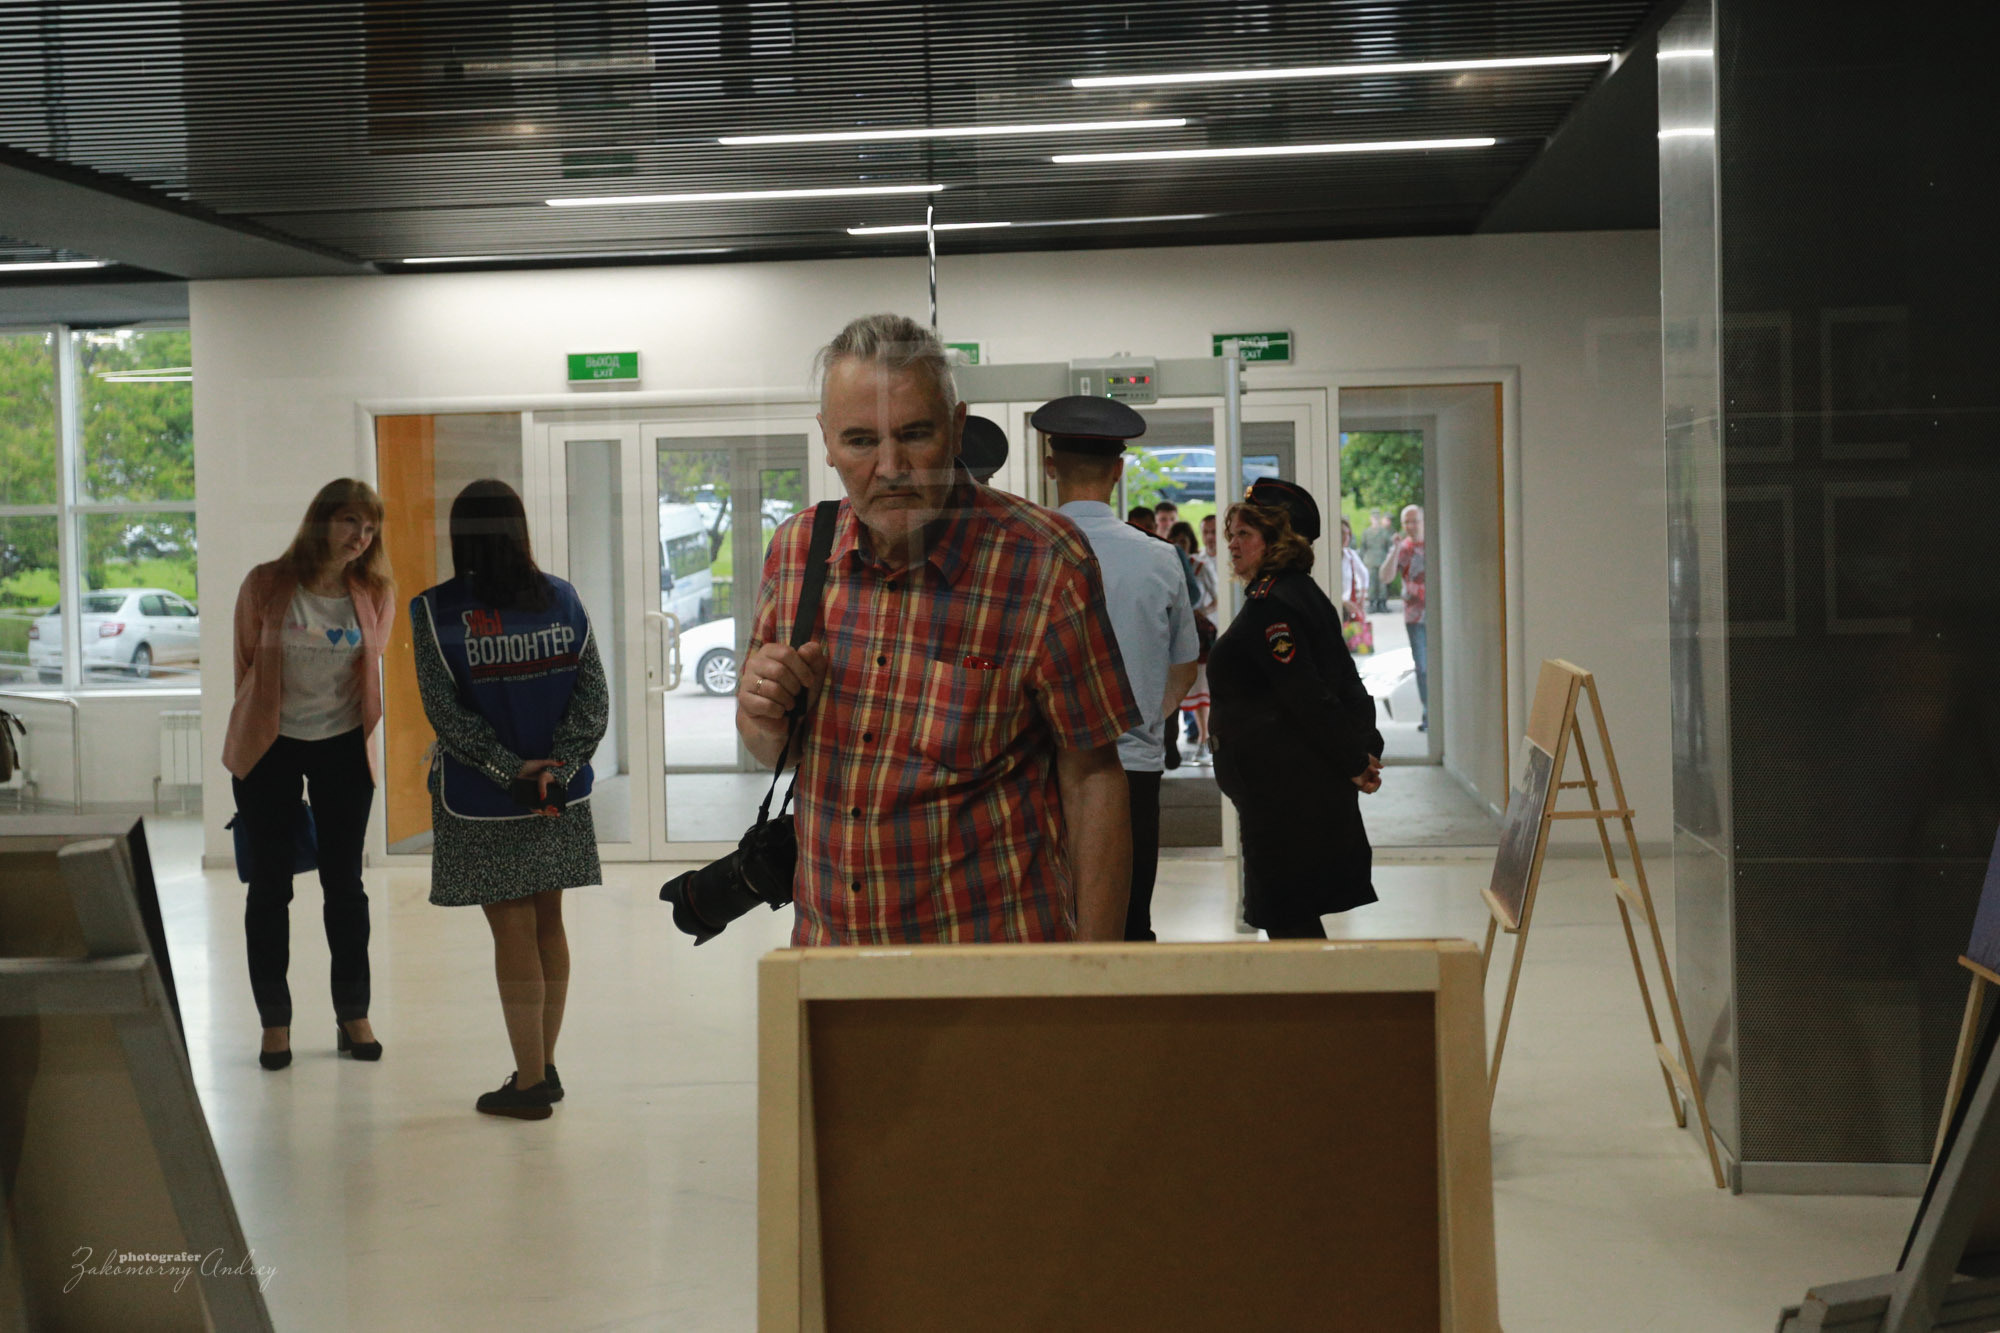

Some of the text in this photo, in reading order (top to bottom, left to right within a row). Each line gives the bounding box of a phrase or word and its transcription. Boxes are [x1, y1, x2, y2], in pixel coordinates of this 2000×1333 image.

[1240, 349, 1263, 359] EXIT
[585, 355, 621, 368] ВЫХОД
[593, 367, 614, 378] EXIT
[464, 622, 575, 667] ВОЛОНТЁР
